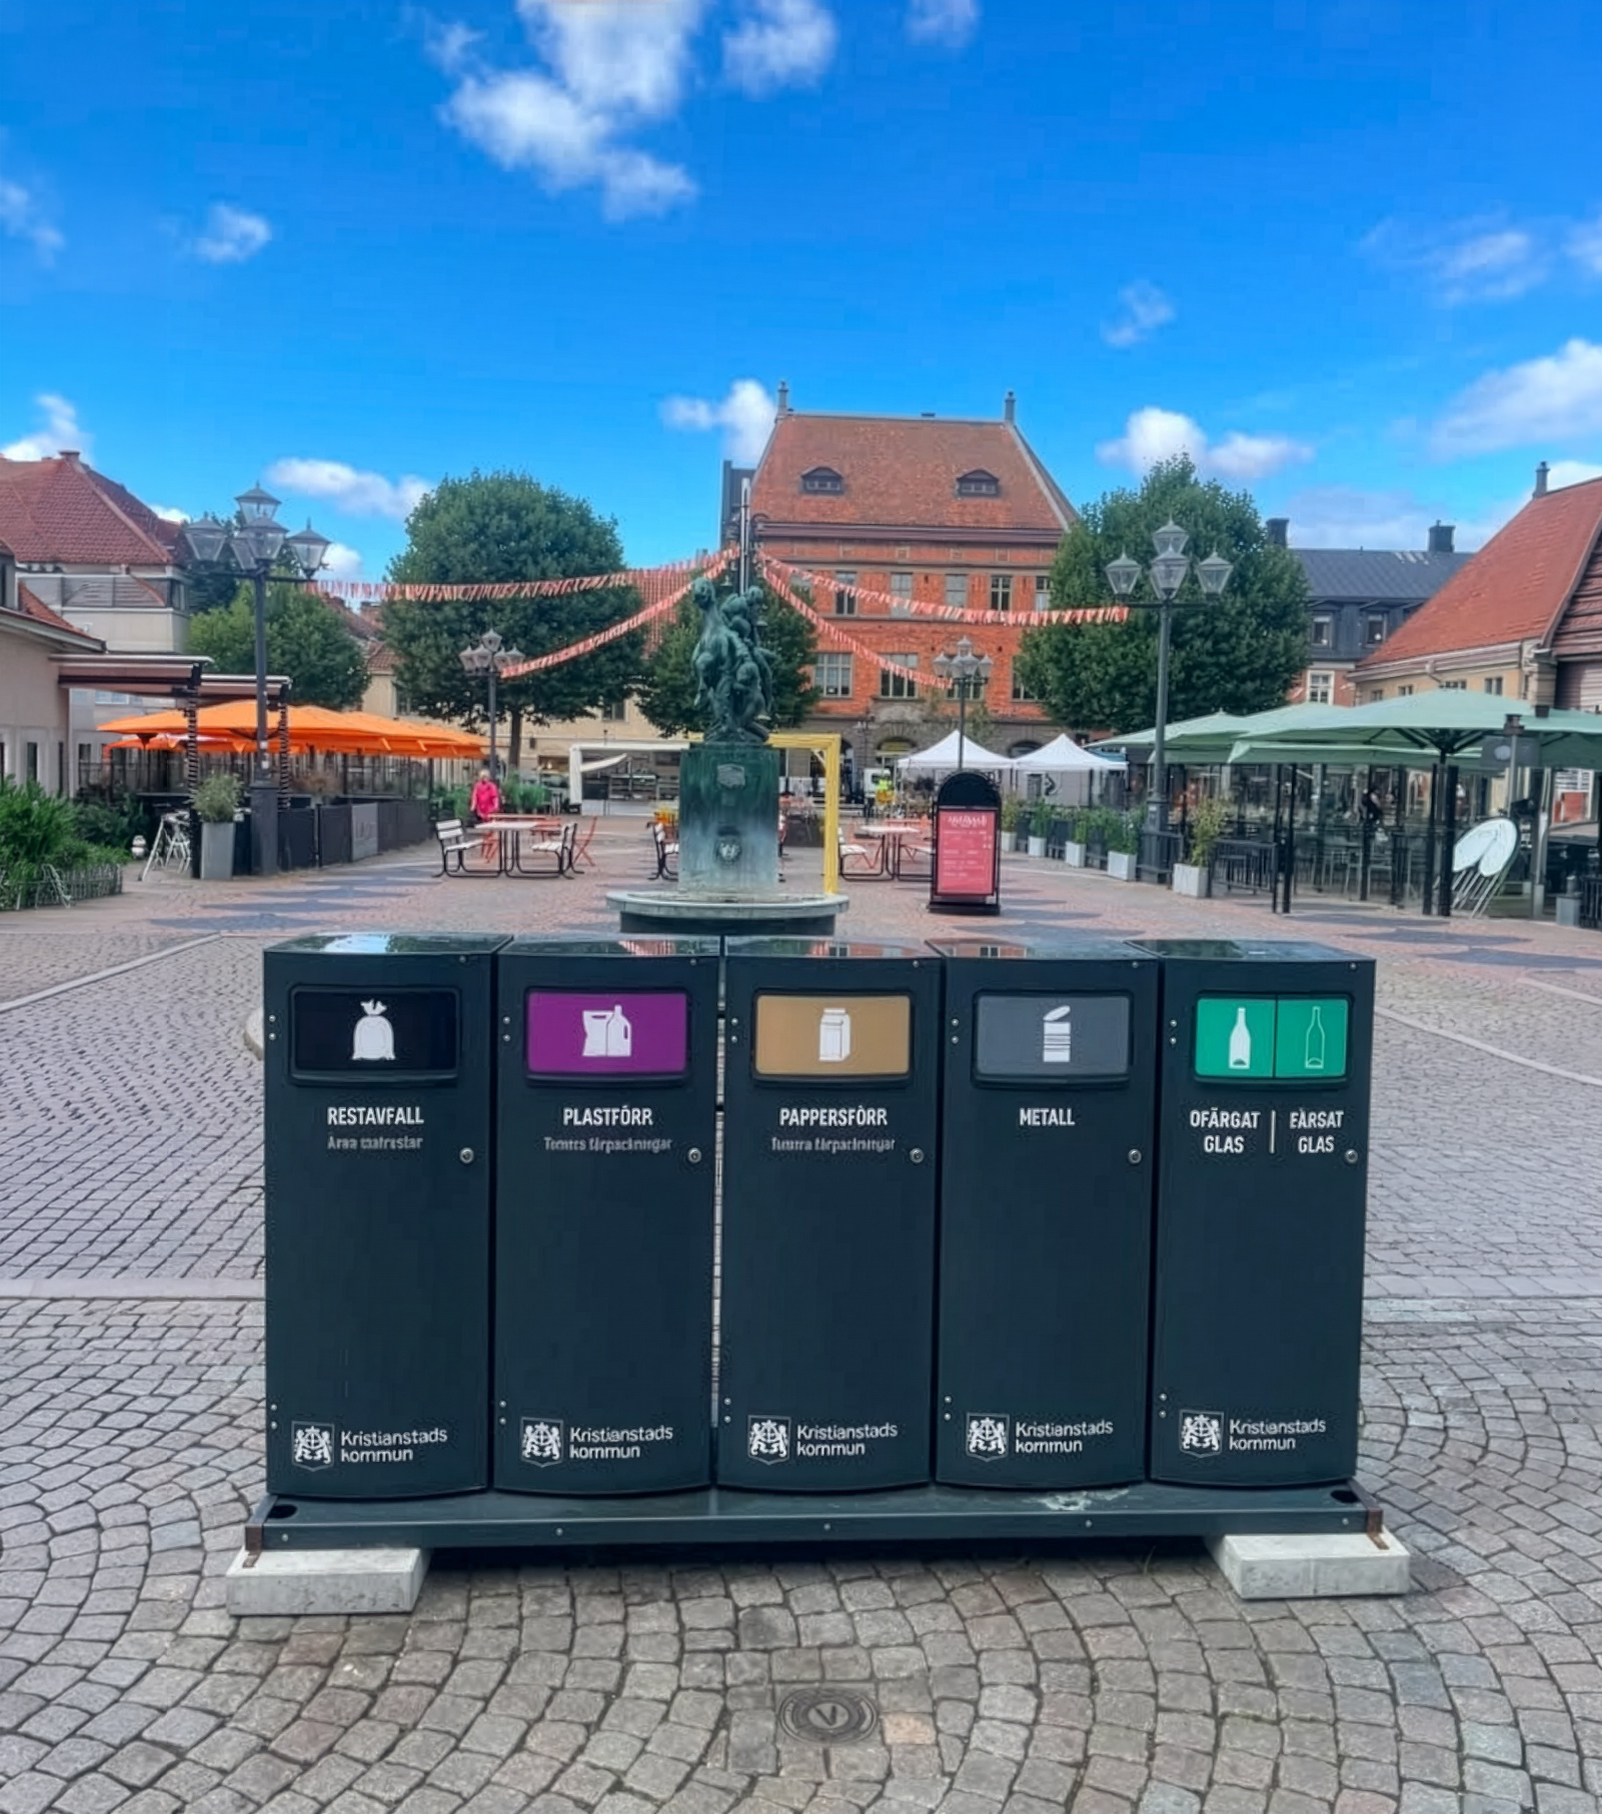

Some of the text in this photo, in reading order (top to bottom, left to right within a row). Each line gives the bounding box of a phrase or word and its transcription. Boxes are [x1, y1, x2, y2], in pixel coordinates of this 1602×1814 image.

[327, 1106, 425, 1126] RESTAVFALL
[1019, 1107, 1076, 1127] METALL
[1203, 1134, 1245, 1154] GLAS
[1297, 1135, 1335, 1154] GLAS
[569, 1424, 673, 1443] Kristianstads
[797, 1422, 898, 1441] Kristianstads
[1015, 1419, 1113, 1438] Kristianstads
[1228, 1418, 1327, 1435] Kristianstads
[340, 1427, 448, 1446] Kristianstads
[1015, 1438, 1083, 1454] kommun
[1229, 1435, 1296, 1451] kommun
[341, 1448, 414, 1463] kommun
[569, 1444, 641, 1459] kommun
[797, 1441, 866, 1457] kommun
